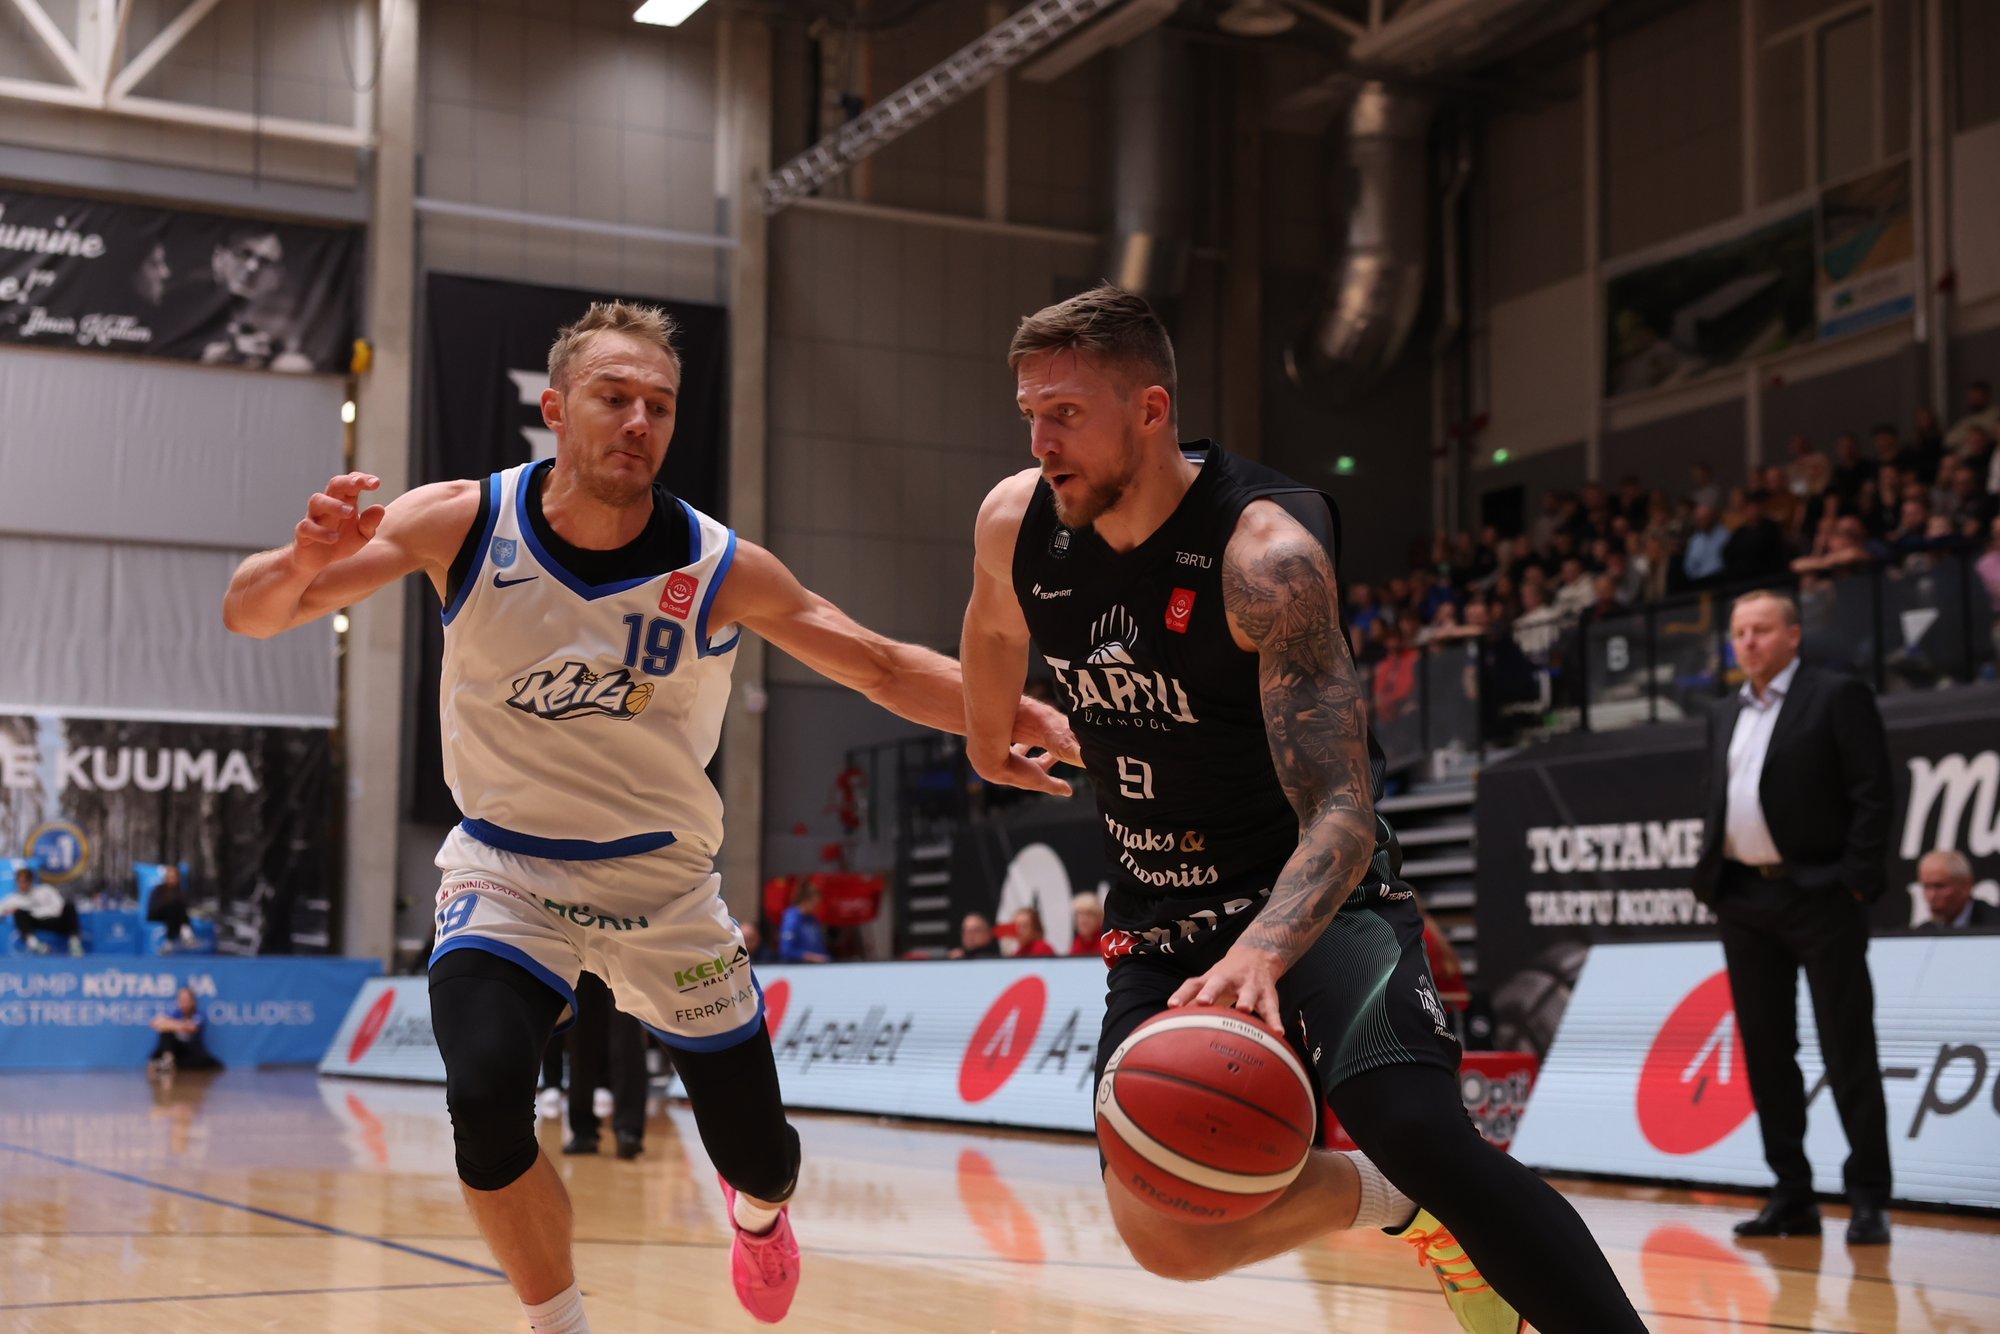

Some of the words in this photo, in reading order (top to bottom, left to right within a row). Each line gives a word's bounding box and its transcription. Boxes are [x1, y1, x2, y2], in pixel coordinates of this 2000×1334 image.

[622, 612, 686, 677] 19
[1043, 654, 1200, 724] TARTU
[57, 746, 258, 793] KUUMA
[1116, 756, 1155, 799] 9
[1105, 813, 1175, 852] Maks
[1179, 830, 1206, 853] &
[1119, 849, 1219, 888] Moorits
[1525, 889, 1614, 925] TARTU
[82, 968, 177, 998] KÜTAB
[674, 945, 748, 987] KEILA
[206, 1001, 316, 1026] OLUDES
[1132, 1174, 1227, 1217] molten
